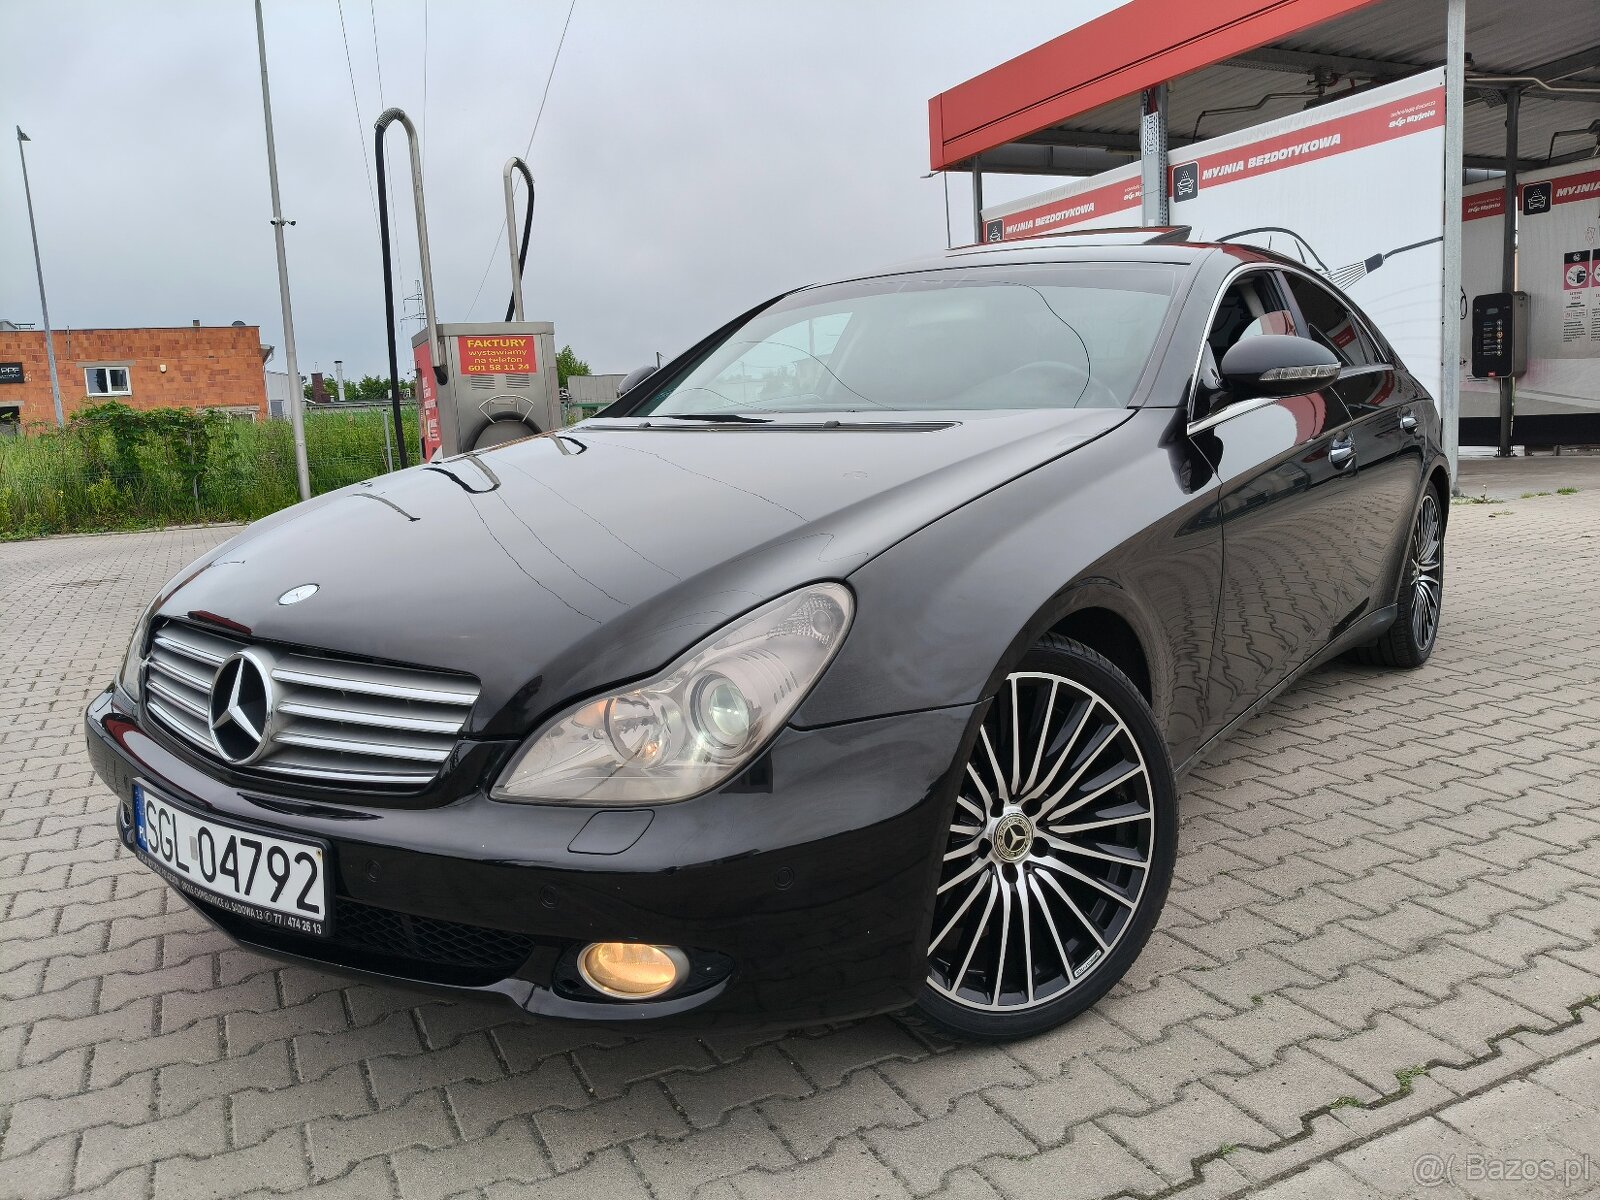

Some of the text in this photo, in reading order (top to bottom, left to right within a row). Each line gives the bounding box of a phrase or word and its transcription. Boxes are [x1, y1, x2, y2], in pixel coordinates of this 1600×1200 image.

[1202, 133, 1341, 180] MYJNIA BEZDOTYKOWA
[1005, 203, 1095, 234] MYJNIA BEZDOTYKOWA
[467, 339, 526, 348] FAKTURY
[468, 348, 528, 357] wystawiamy
[146, 799, 190, 873] SGL
[198, 826, 320, 915] 04792
[273, 913, 282, 924] 77
[287, 916, 301, 929] 474
[302, 920, 311, 932] 26
[313, 922, 322, 935] 13
